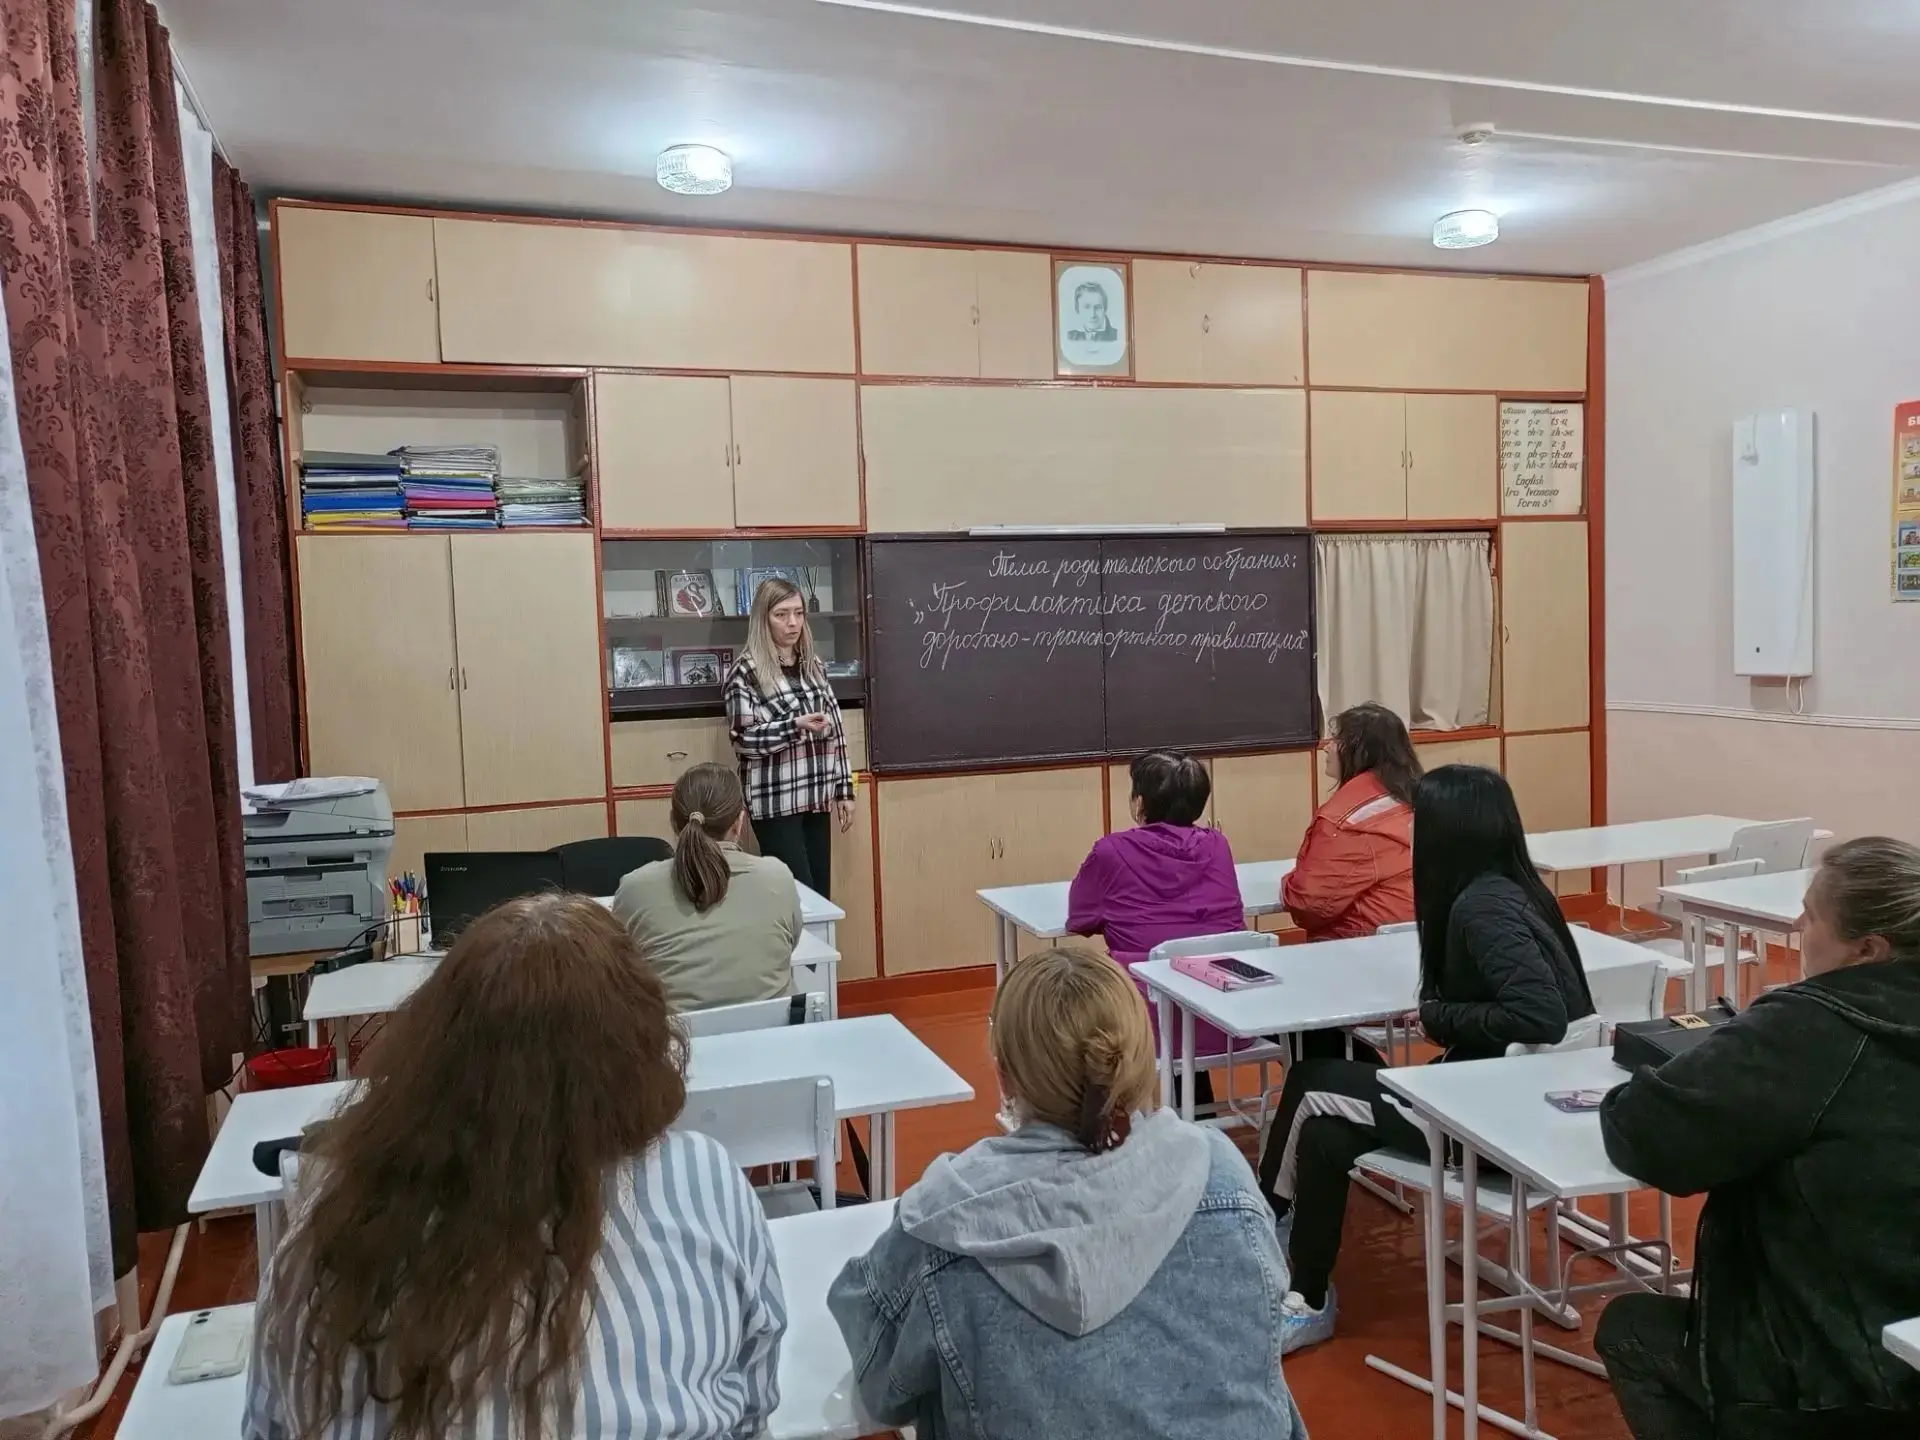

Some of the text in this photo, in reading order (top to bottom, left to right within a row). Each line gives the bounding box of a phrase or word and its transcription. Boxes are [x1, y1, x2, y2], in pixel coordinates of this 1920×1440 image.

[1515, 473, 1544, 489] English
[1517, 498, 1540, 508] Form
[988, 547, 1297, 588] Тема родительского собрания:
[1154, 591, 1269, 635] детского
